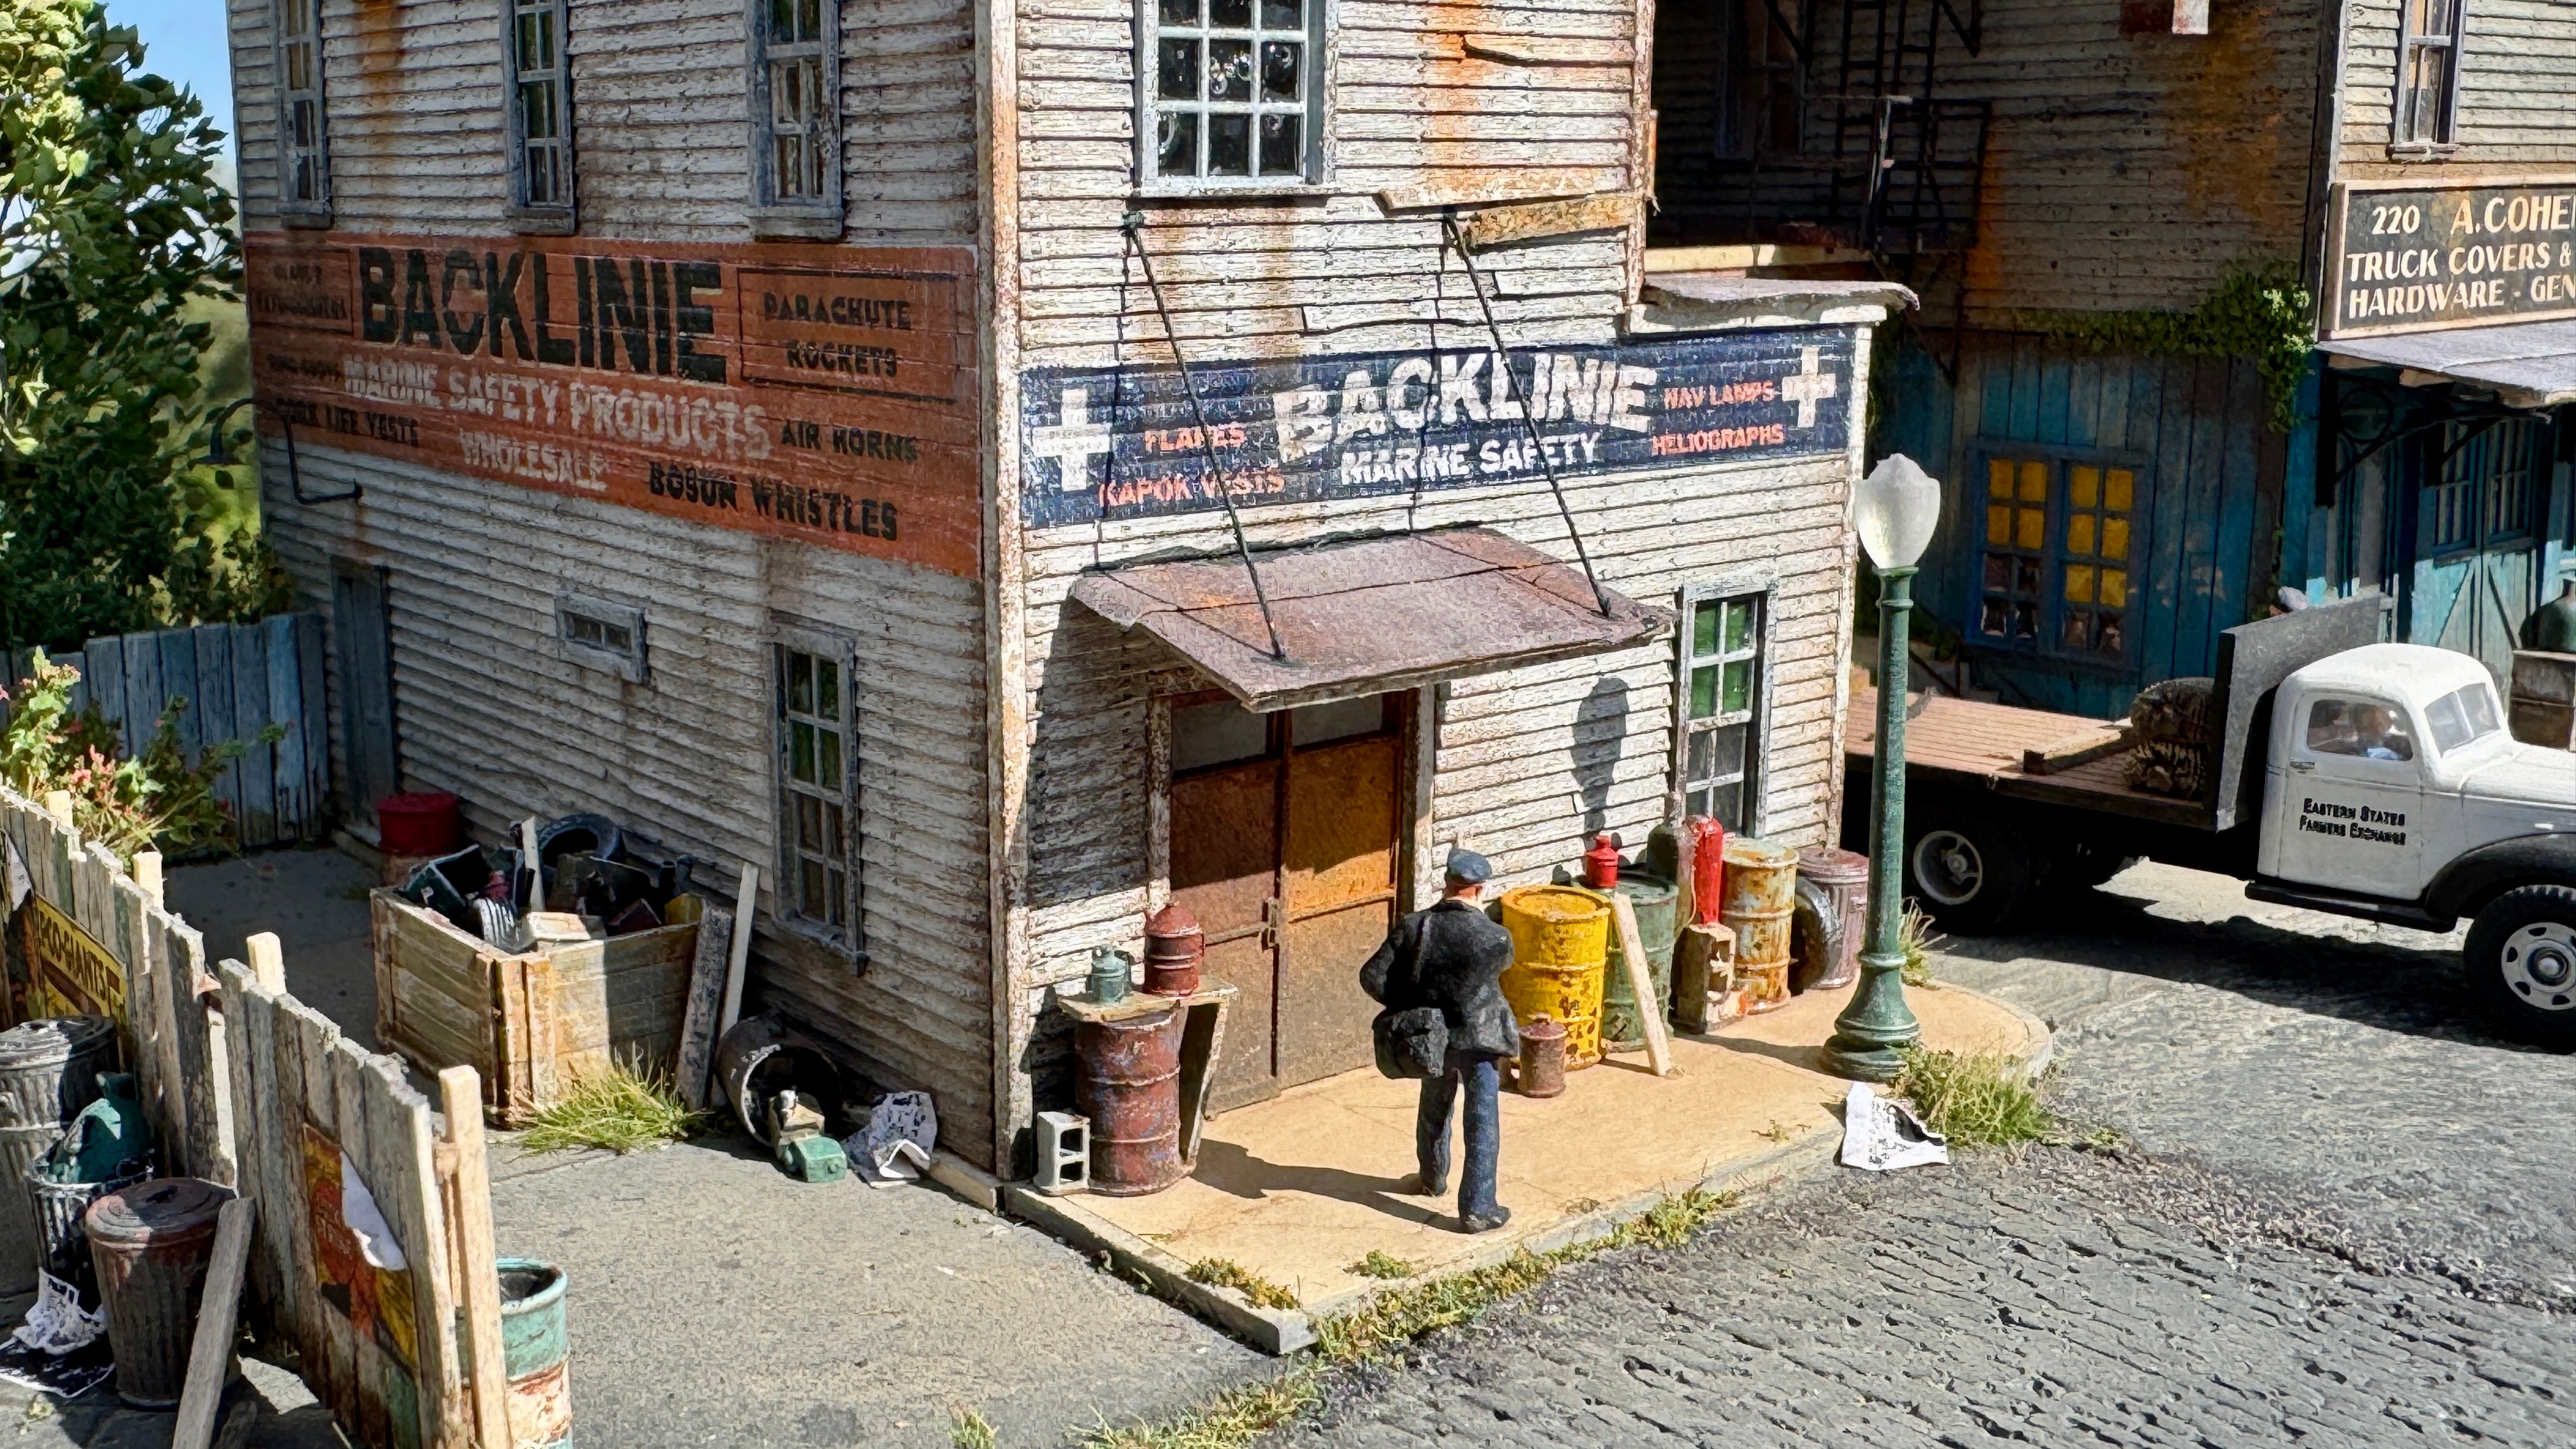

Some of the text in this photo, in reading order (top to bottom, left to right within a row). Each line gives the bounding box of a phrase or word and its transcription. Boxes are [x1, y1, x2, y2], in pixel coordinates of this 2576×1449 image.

[2372, 194, 2576, 236] 220 A.COHE
[2347, 241, 2572, 282] TRUCK COVERS &
[359, 247, 726, 384] BACKLINIE
[763, 292, 912, 330] PARACHUTE
[2349, 279, 2505, 319] HARDWARE
[785, 340, 898, 378] ROCKETS
[448, 364, 559, 426] SAFETY
[570, 381, 773, 461] PRODUCTS
[1664, 387, 1705, 410] NAV
[1710, 380, 1776, 406] LAMPS
[781, 418, 917, 464] AIR HORNS
[1342, 431, 1601, 485] MARINE SAFETY
[1651, 423, 1784, 456] HELIOGRAPHS
[648, 461, 898, 542] BOSUN WHISTLES
[1099, 475, 1193, 507] KAPOK
